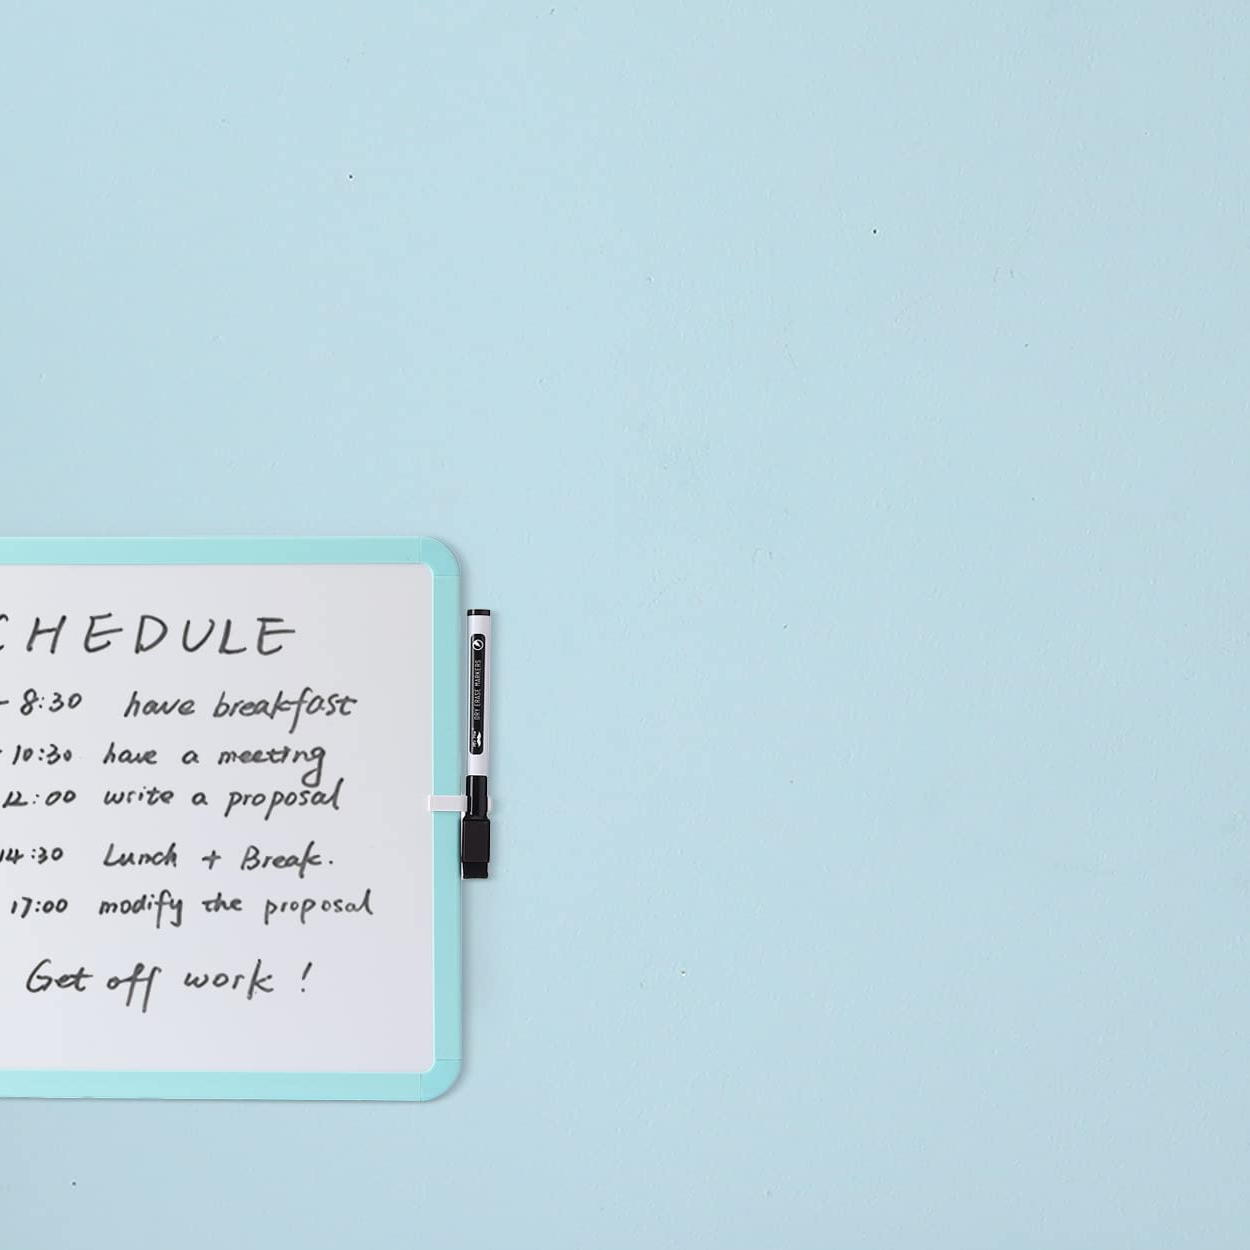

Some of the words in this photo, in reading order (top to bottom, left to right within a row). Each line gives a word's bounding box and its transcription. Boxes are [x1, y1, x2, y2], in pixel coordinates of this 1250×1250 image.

[474, 659, 482, 687] MARKERS
[123, 690, 196, 718] have
[212, 686, 358, 734] breakfast
[473, 708, 481, 721] DRY
[474, 688, 482, 707] ERASE
[102, 741, 158, 765] have
[181, 749, 200, 765] a
[217, 745, 327, 788] meeting
[103, 785, 175, 806] write
[191, 791, 209, 806] a
[223, 777, 344, 821] proposal
[102, 843, 178, 868] Lunch
[98, 890, 184, 930] modify
[201, 891, 243, 913] the
[264, 887, 374, 926] proposal
[25, 958, 94, 994] Get
[106, 962, 163, 1013] off
[183, 958, 275, 1001] work
